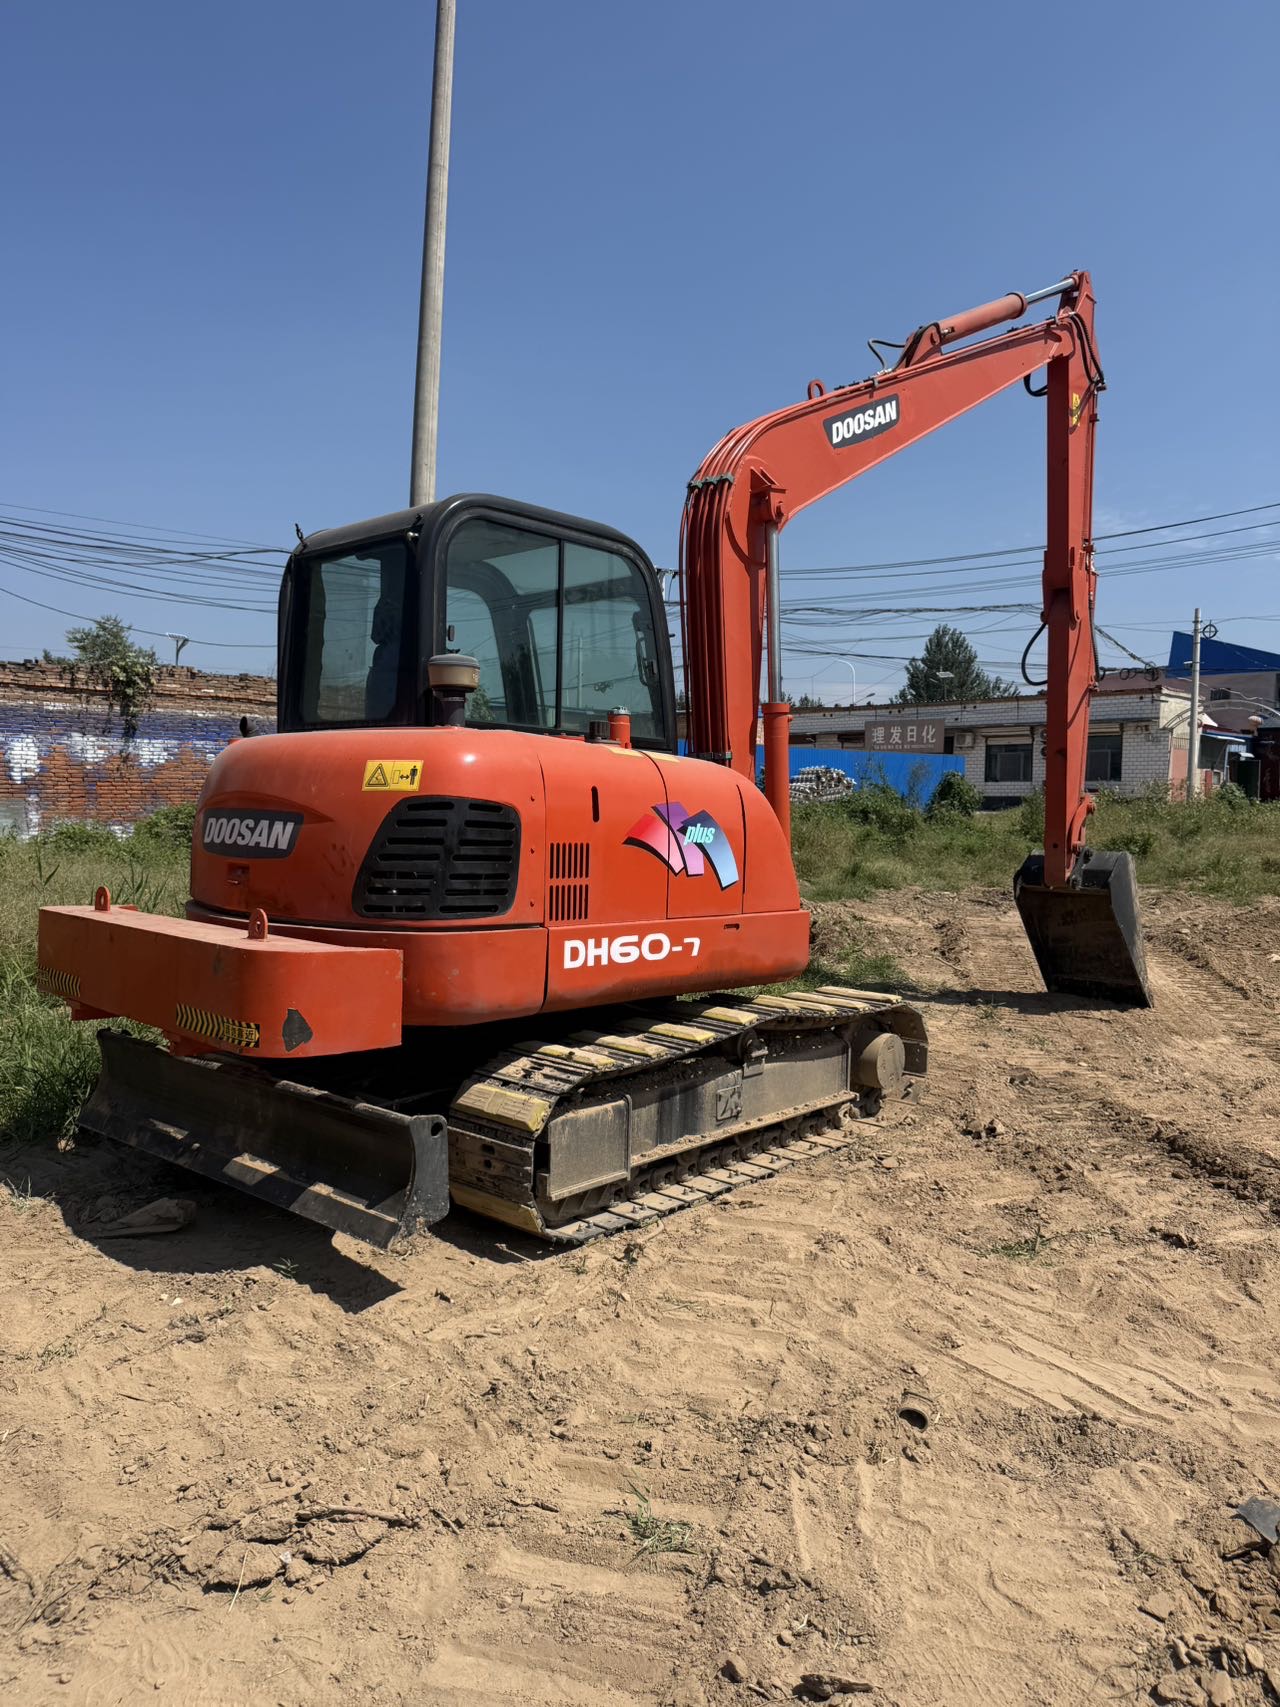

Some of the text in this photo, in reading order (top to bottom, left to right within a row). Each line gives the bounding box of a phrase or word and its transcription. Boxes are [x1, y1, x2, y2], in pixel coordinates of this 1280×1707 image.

[831, 400, 897, 444] DOOSAN
[871, 725, 937, 744] 理发日化
[203, 817, 295, 850] DOOSAN
[683, 823, 716, 846] plus
[563, 932, 701, 969] DH60-7
